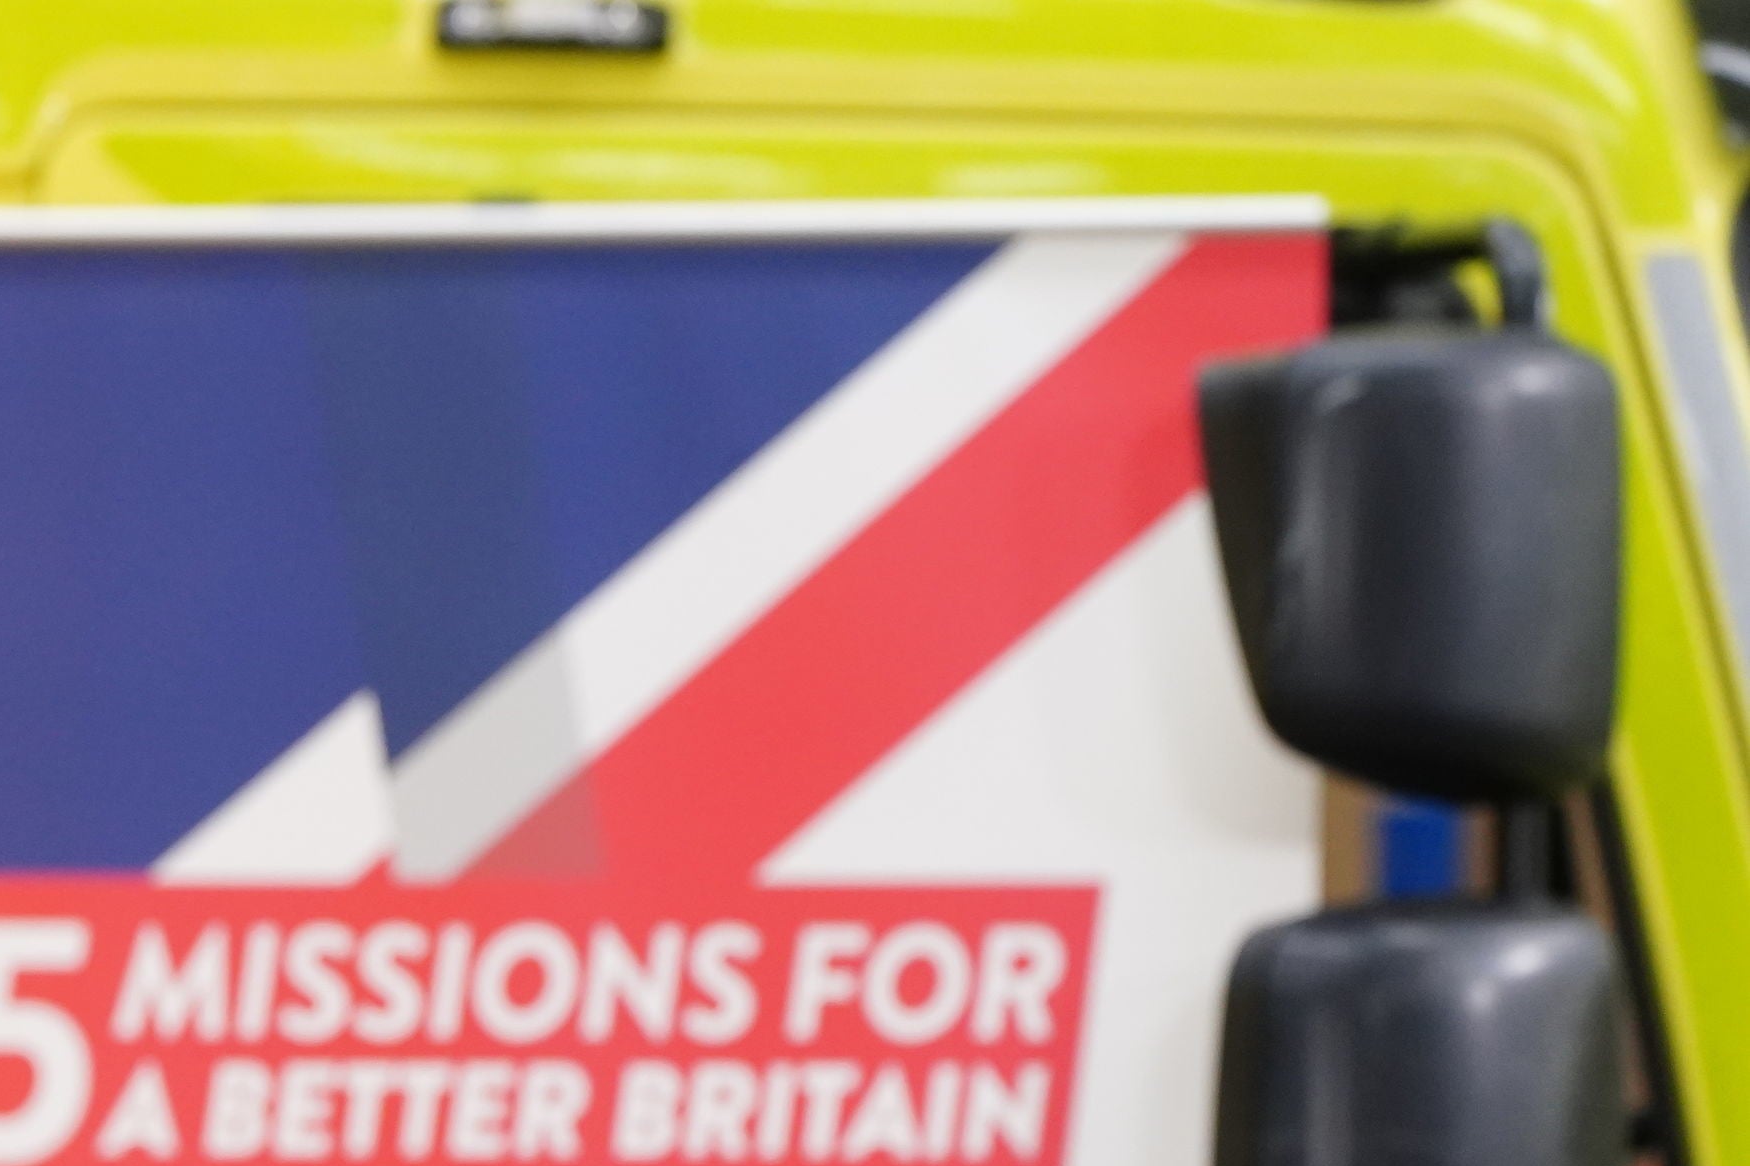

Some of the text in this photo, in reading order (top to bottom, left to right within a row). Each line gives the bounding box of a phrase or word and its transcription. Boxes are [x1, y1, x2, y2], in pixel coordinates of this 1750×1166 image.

[110, 920, 763, 1046] MISSIONS
[783, 920, 1069, 1046] FOR
[94, 1057, 1052, 1163] A BETTER BRITAIN
